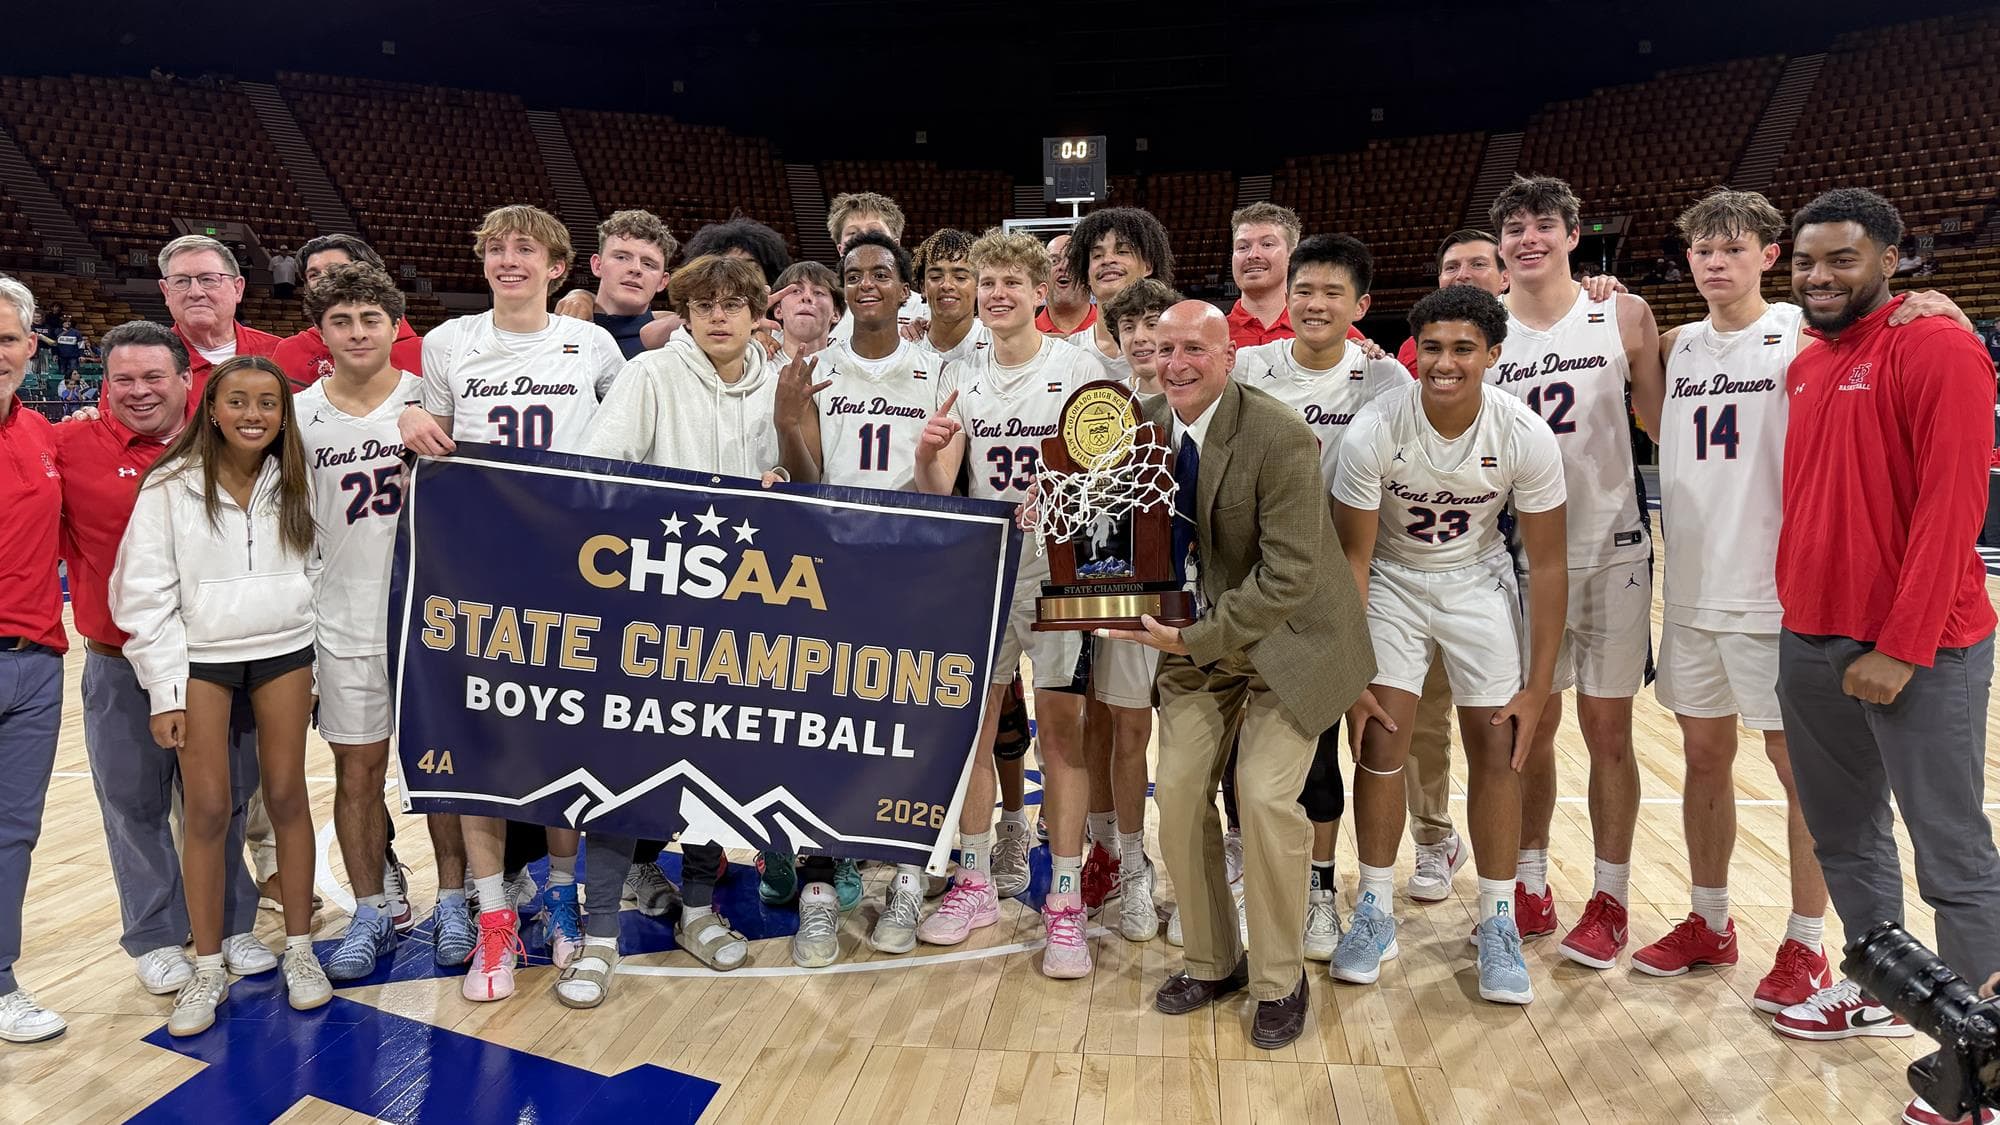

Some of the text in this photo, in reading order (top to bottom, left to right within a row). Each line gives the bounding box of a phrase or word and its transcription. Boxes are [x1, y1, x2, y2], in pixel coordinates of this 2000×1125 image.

[1944, 221, 1961, 232] 221
[134, 253, 149, 265] 214
[1919, 238, 1934, 249] 122
[81, 261, 96, 273] 113
[1495, 353, 1608, 386] Kent Denver
[461, 375, 578, 398] Kent Denver
[1672, 373, 1777, 400] Kent Denver
[826, 395, 927, 419] Kent Denver
[1067, 394, 1092, 430] COLORADO
[1093, 391, 1112, 400] HIGH
[1526, 381, 1577, 435] 12
[487, 404, 553, 451] 30
[971, 417, 1058, 438] Kent Denver
[1693, 404, 1740, 461] 14
[313, 447, 357, 469] Kent
[859, 422, 892, 472] 11
[986, 446, 1040, 491] 33
[340, 463, 402, 526] 25
[1385, 480, 1498, 505] Kent Denver
[1405, 506, 1472, 545] 23
[577, 534, 828, 611] CHSAA
[1063, 583, 1144, 595] STATE CHAMPION
[420, 594, 975, 710] STATE CHAMPIONS
[465, 675, 915, 759] BOYS BASKETBALL
[417, 749, 455, 776] 4A
[876, 798, 945, 830] 2026
